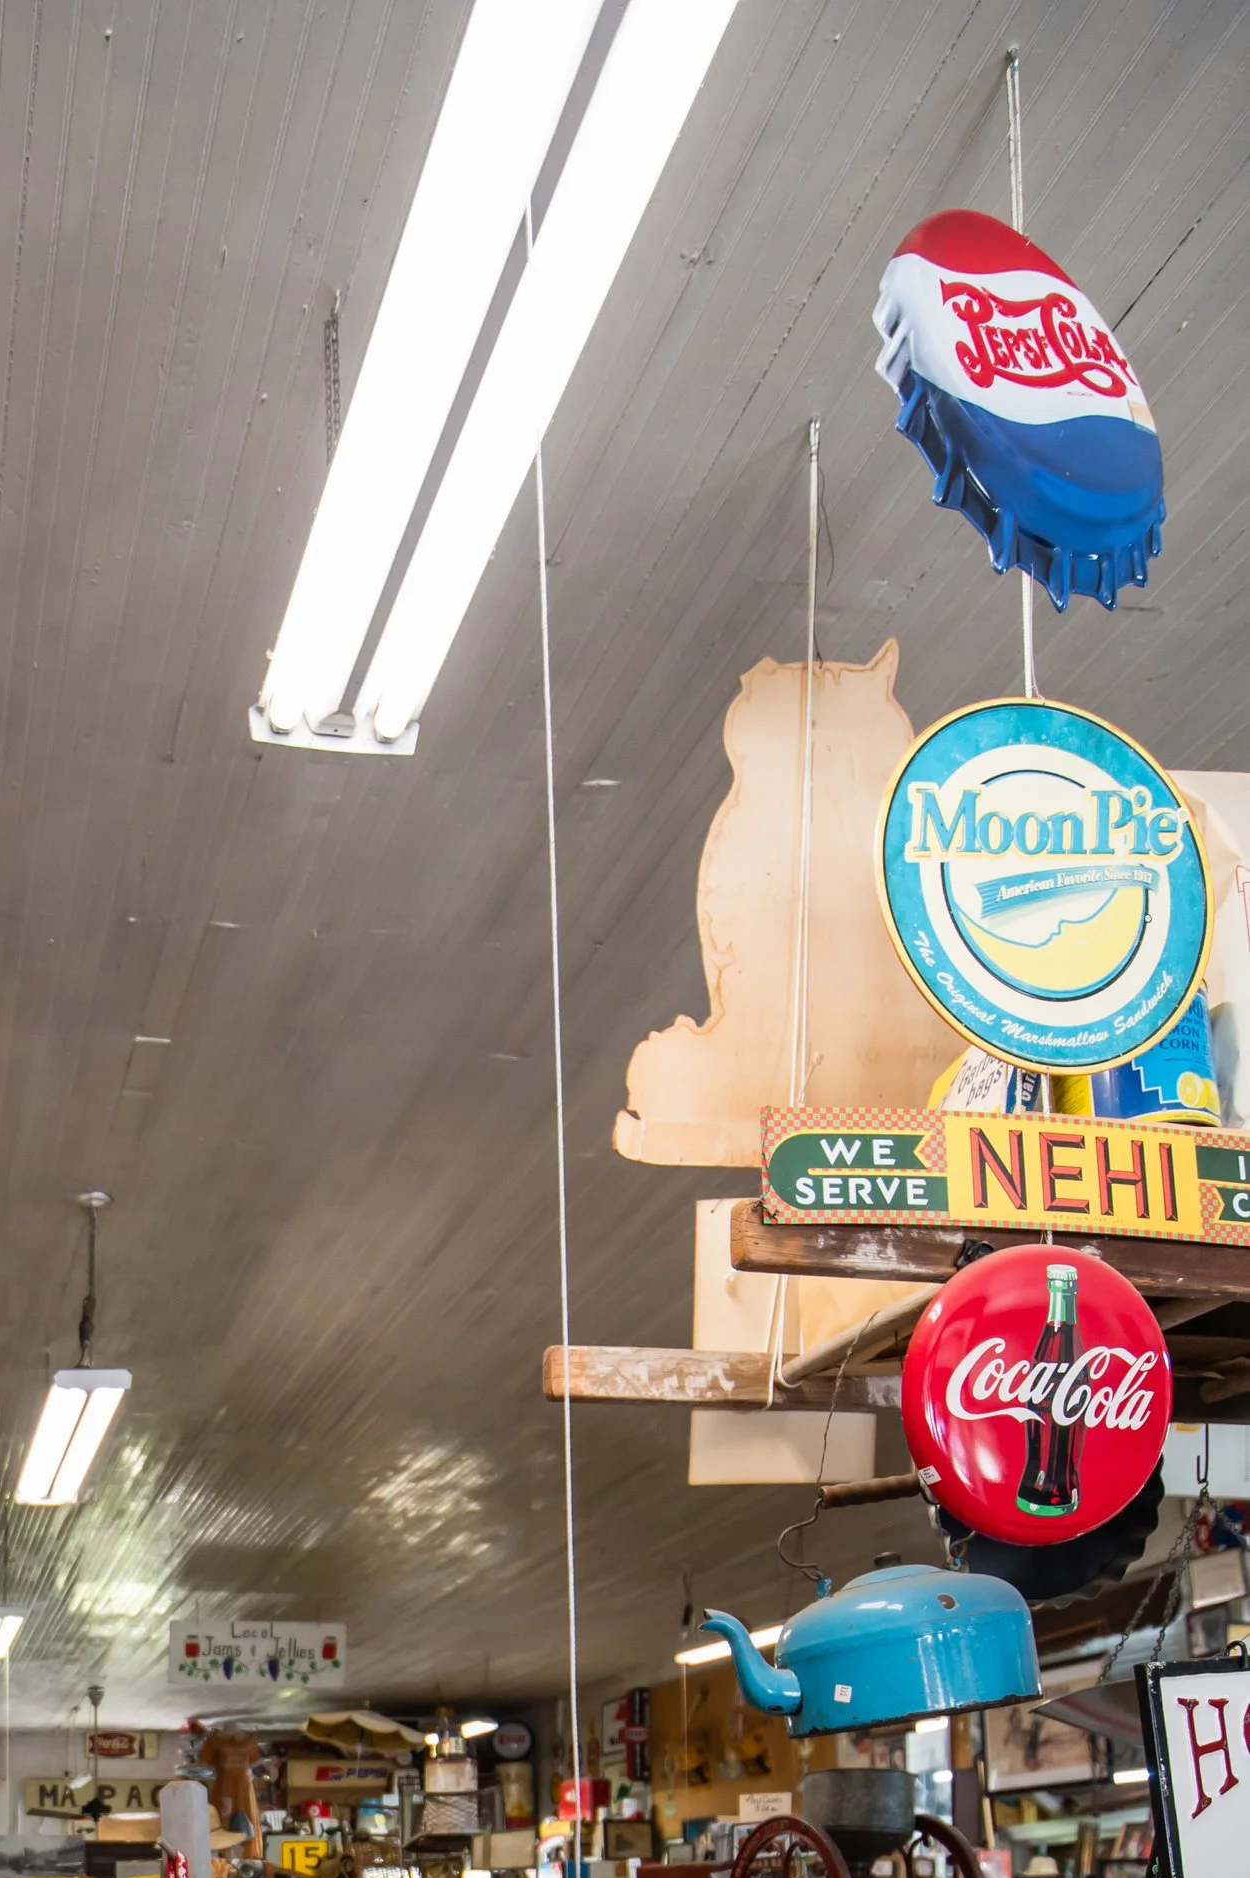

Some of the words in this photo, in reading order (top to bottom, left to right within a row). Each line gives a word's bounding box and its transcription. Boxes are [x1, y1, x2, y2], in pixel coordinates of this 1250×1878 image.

[995, 879, 1055, 902] American
[1056, 873, 1101, 887] Favorite
[1104, 868, 1131, 881] Since
[913, 929, 936, 967] The
[936, 971, 995, 1026] Original
[1001, 1018, 1110, 1048] Marshmallow
[1113, 970, 1174, 1035] Sandwich
[820, 1137, 896, 1167] WE
[969, 1126, 1179, 1222] NEHI
[795, 1176, 929, 1206] SERVE
[946, 1337, 1159, 1431] Coca-Cola
[231, 1622, 281, 1639] Local
[201, 1636, 242, 1657] Jams
[267, 1636, 315, 1659] Jellies
[347, 1767, 387, 1779] PEPSI
